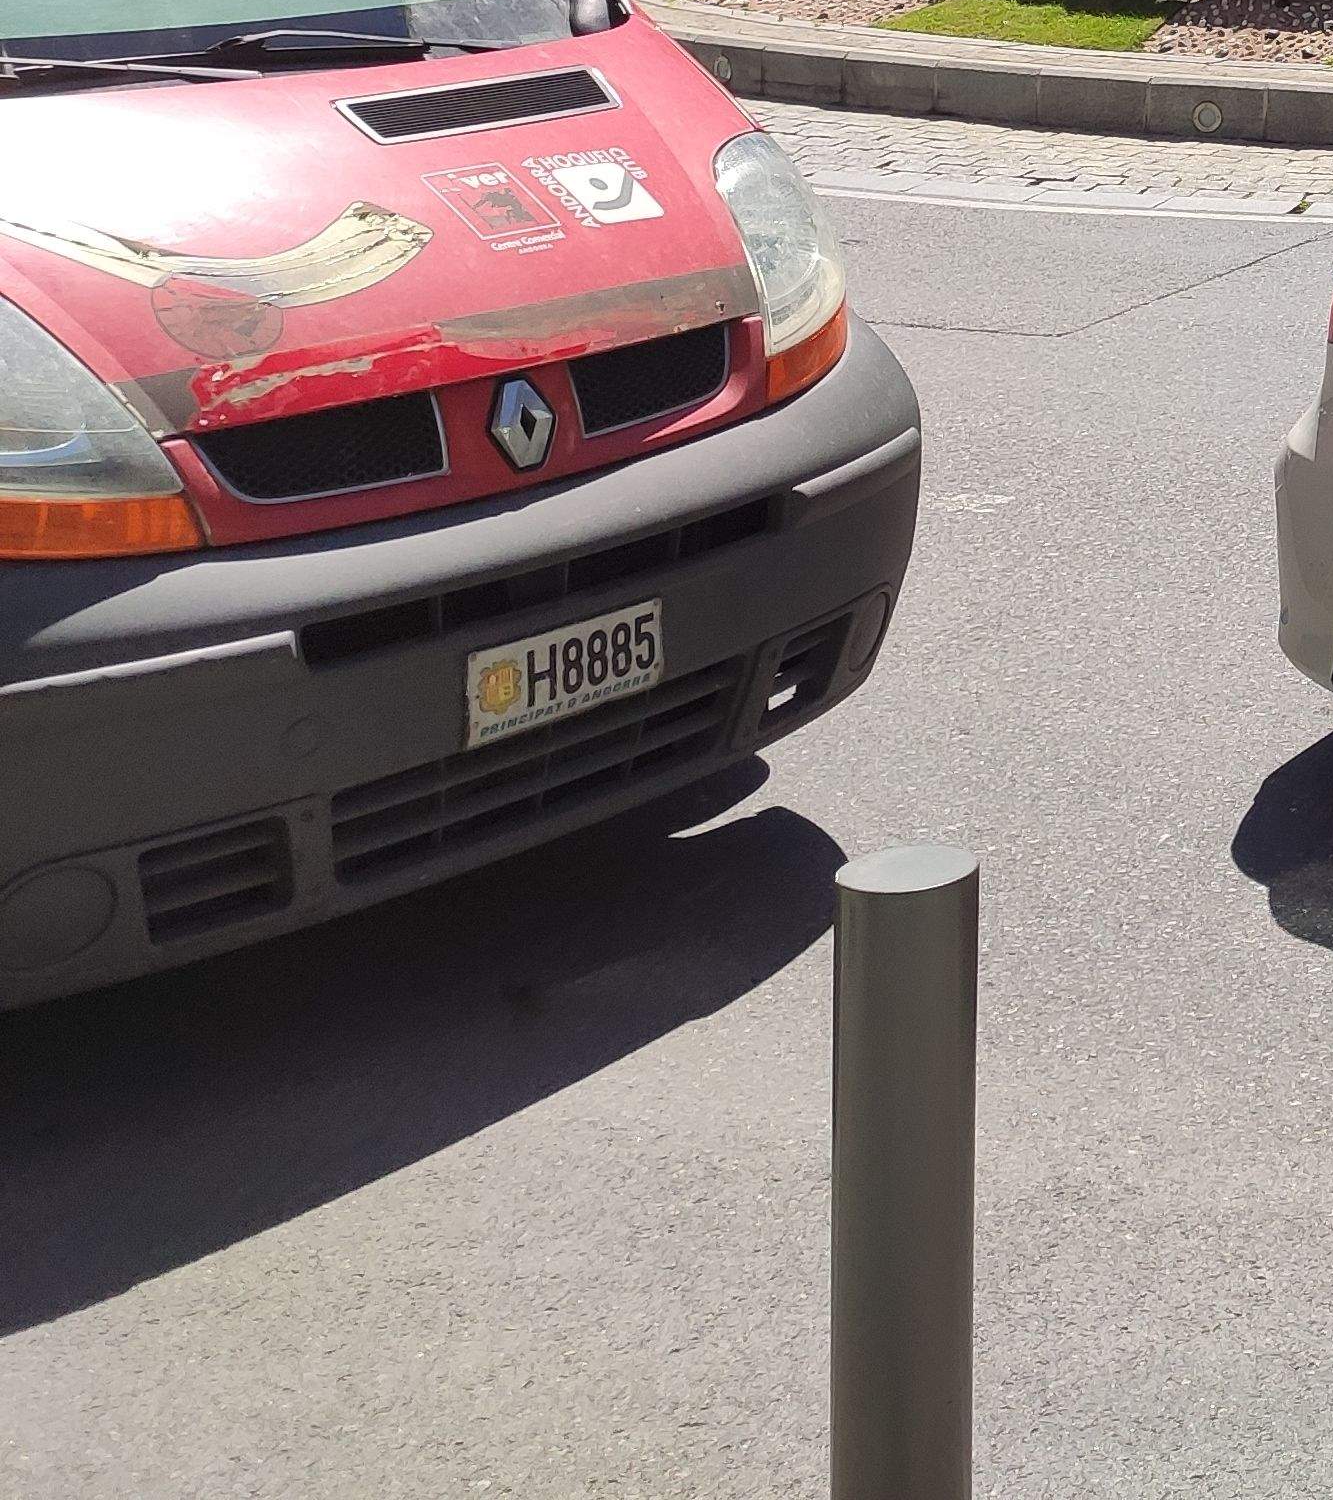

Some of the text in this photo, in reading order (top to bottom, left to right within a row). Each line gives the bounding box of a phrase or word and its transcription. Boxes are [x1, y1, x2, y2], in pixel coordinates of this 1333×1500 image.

[538, 149, 617, 171] HOQUEI
[521, 157, 602, 228] ANDORRA
[526, 612, 655, 708] H8885
[479, 701, 563, 738] PRINCIPAT
